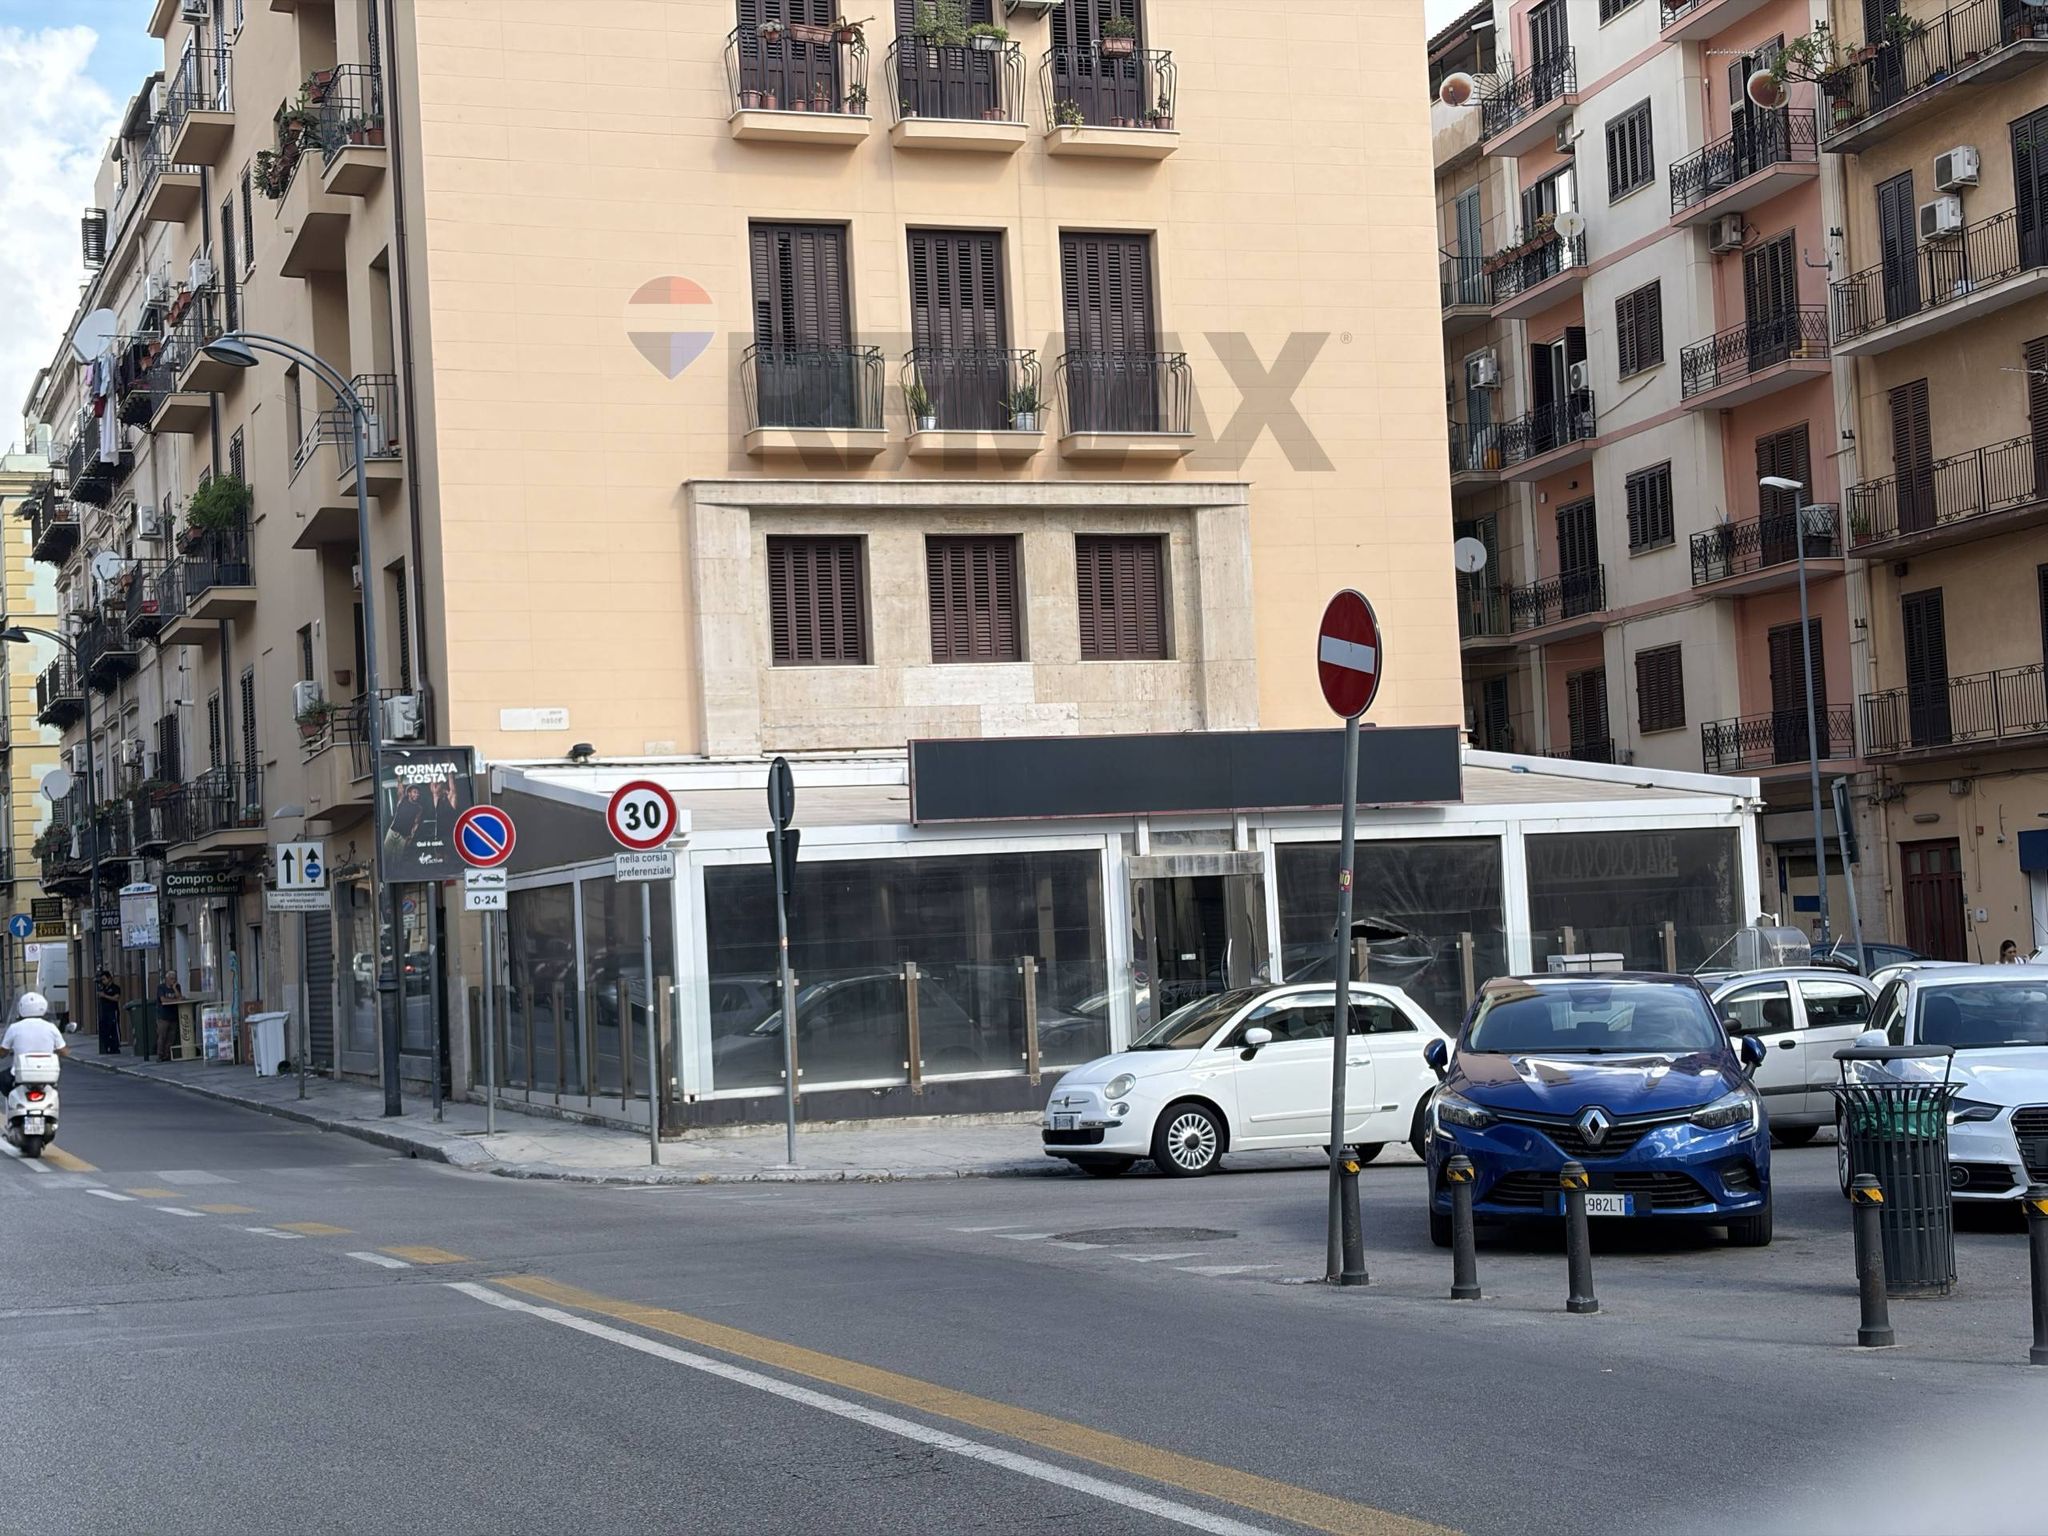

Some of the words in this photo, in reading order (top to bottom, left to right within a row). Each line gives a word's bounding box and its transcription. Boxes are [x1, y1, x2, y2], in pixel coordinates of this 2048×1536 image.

[394, 762, 457, 776] GIORNATA
[407, 773, 446, 784] TOSTA
[624, 800, 661, 831] 30
[620, 854, 640, 864] nella
[642, 853, 667, 863] corsia
[618, 866, 672, 878] preferenziale
[166, 874, 214, 886] Compro
[217, 872, 239, 883] Oro
[167, 887, 199, 896] Argento
[474, 895, 498, 905] 0-24
[101, 917, 119, 925] ORO
[1585, 1198, 1624, 1212] 982LT
